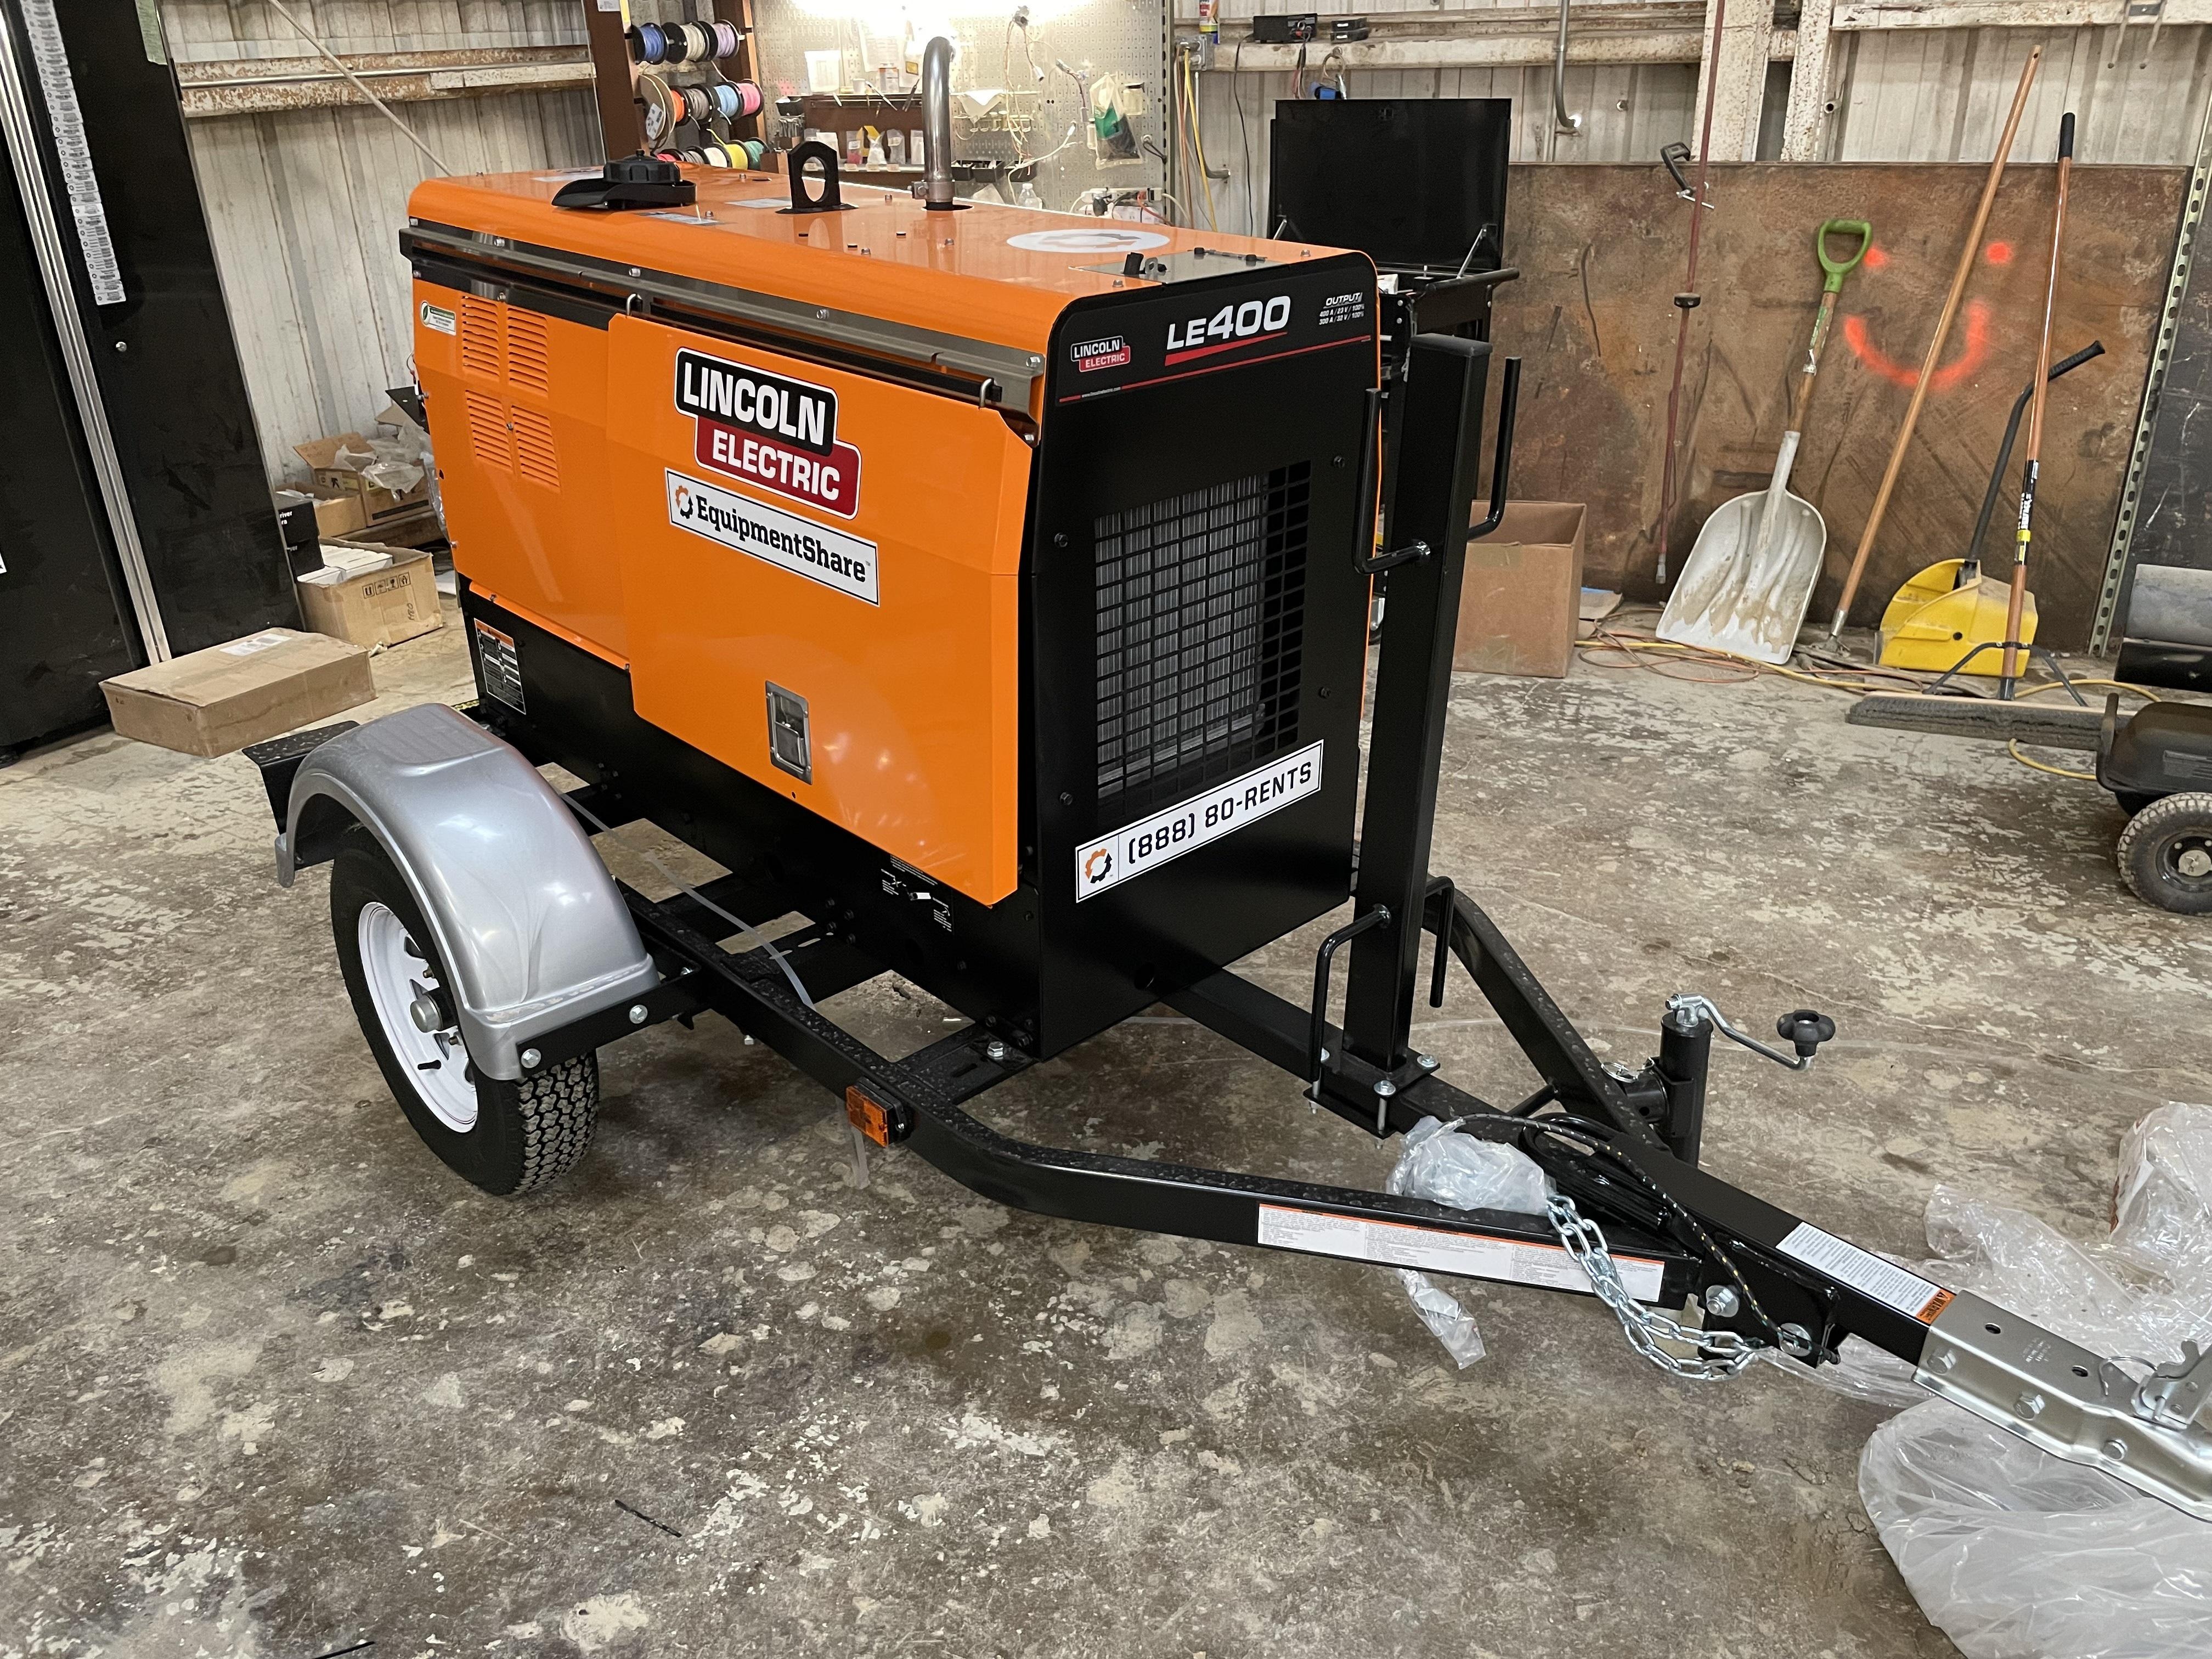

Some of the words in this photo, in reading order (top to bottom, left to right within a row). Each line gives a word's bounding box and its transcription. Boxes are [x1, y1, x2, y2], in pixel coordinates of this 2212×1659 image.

[1166, 296, 1290, 350] LE400
[1325, 292, 1361, 306] OUTPUT
[1074, 339, 1120, 358] LINCOLN
[1085, 353, 1125, 368] ELECTRIC
[684, 362, 826, 445] LINCOLN
[713, 429, 840, 501] ELECTRIC
[696, 495, 866, 583] EquipmentShare
[1128, 813, 1195, 865] (888)
[1205, 761, 1312, 828] 80-RENTS
